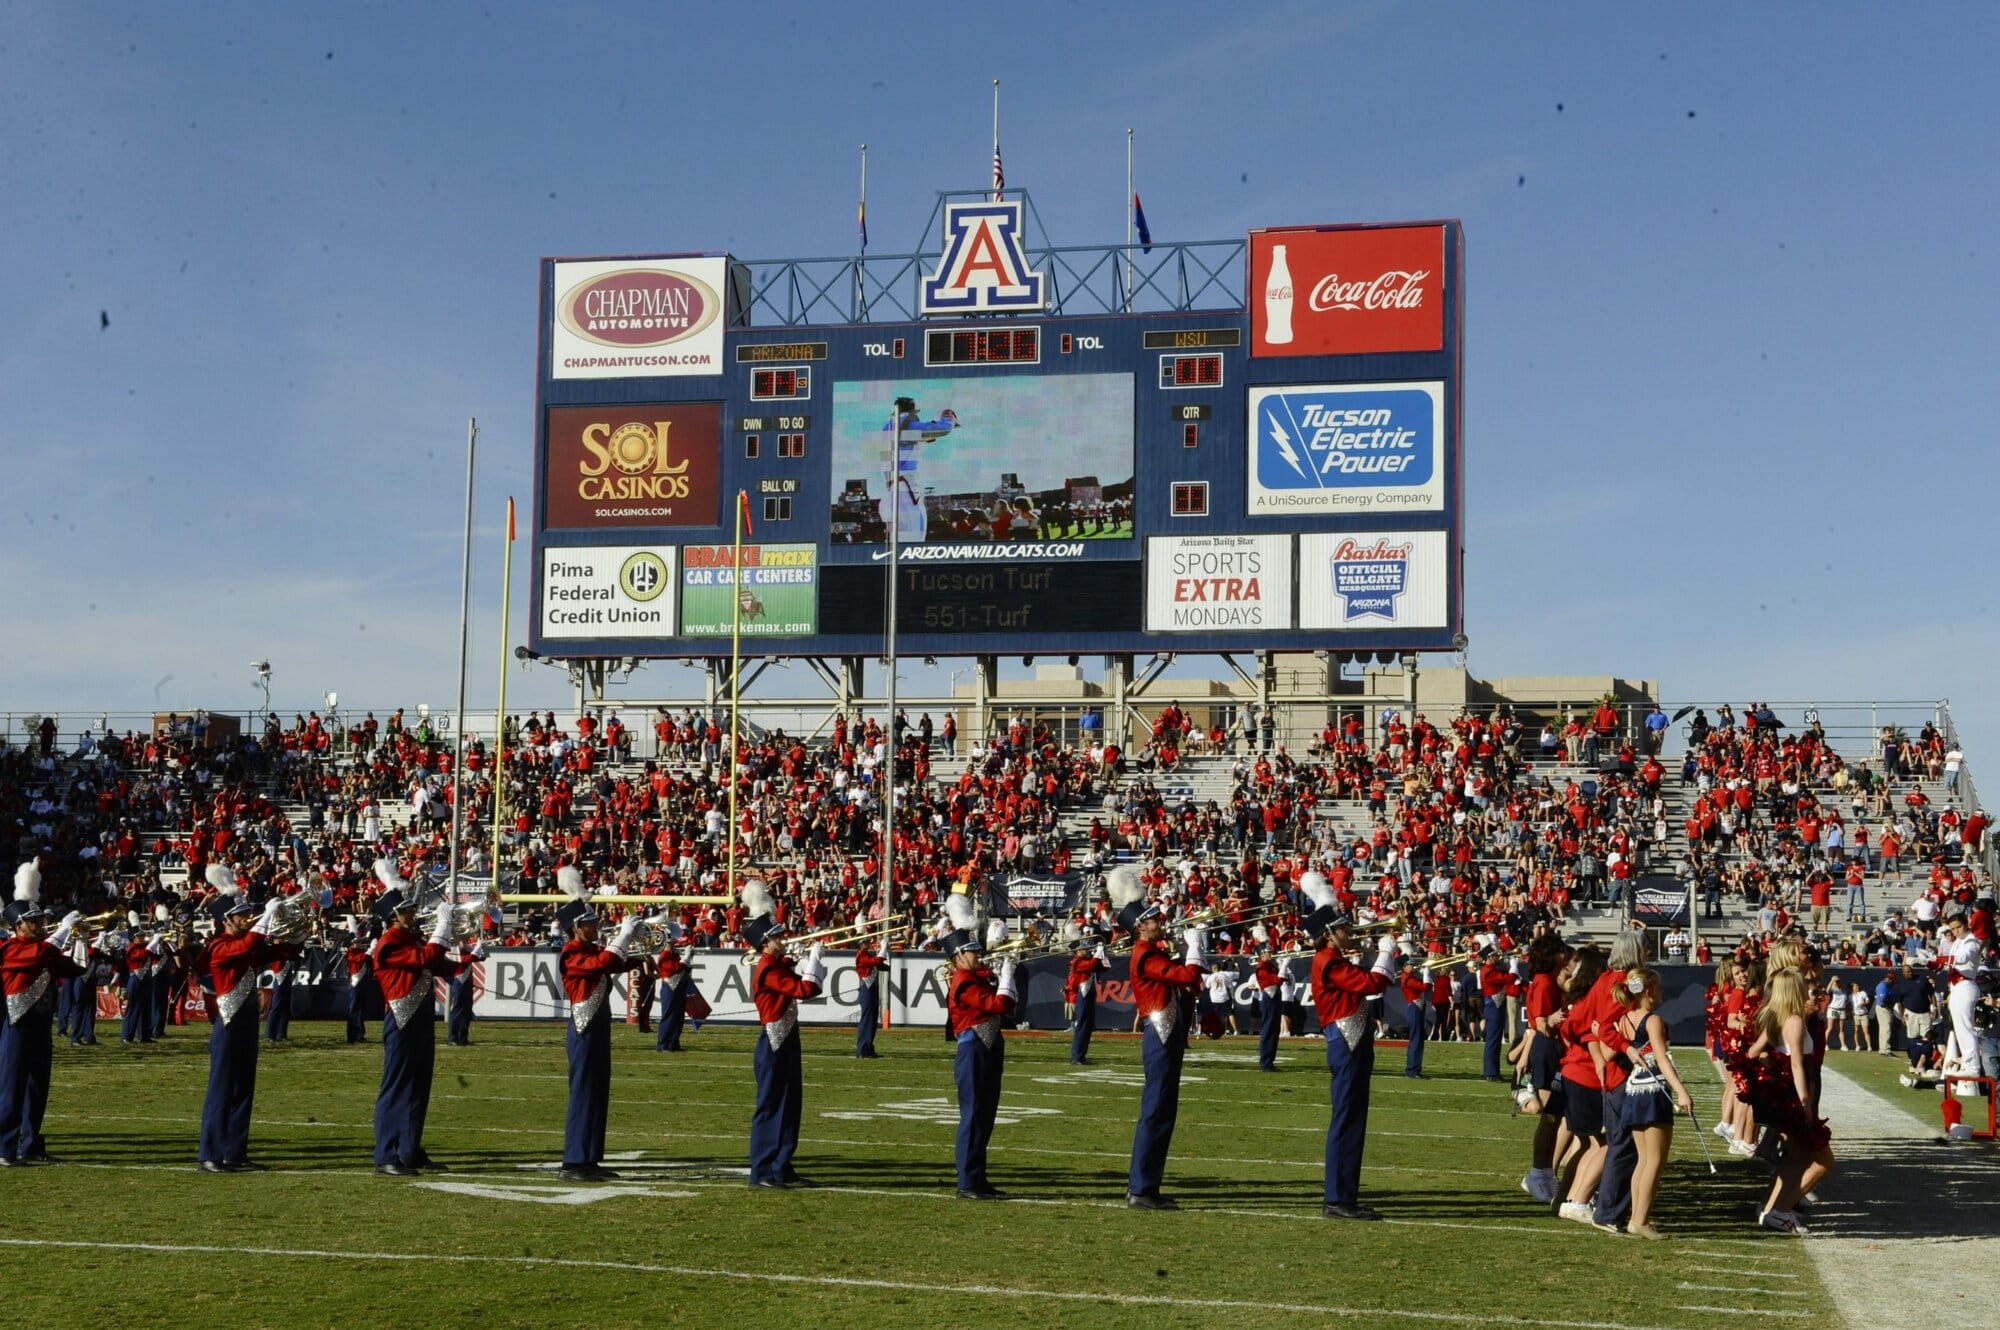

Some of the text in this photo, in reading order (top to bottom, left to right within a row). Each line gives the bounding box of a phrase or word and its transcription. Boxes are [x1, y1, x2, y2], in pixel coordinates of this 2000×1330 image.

[921, 201, 1044, 314] A
[1309, 270, 1430, 312] Coca-Cola
[585, 287, 692, 319] CHAPMAN
[588, 317, 689, 330] AUTOMOTIVE
[953, 330, 1037, 361] 7:26
[1076, 337, 1104, 350] TOL
[1175, 332, 1207, 347] WSU
[752, 345, 813, 361] ARIZONA
[863, 344, 890, 356] TOL
[564, 354, 711, 368] CHAPMANTUCSON.COM
[1175, 357, 1220, 384] 00
[754, 370, 796, 396] 34
[1182, 406, 1199, 419] QTR
[1302, 404, 1391, 428] Tucson
[743, 418, 762, 430] DWN
[779, 417, 804, 429] TO GO
[1310, 426, 1416, 450] Electric
[579, 421, 689, 475] SOL
[1321, 451, 1415, 474] Power
[578, 476, 689, 500] CASINOS
[762, 480, 795, 492] BALL ON
[1256, 492, 1432, 506] A UniSource Energy Company
[595, 507, 672, 517] SOLCASINOS.COM
[1180, 536, 1255, 548] Arizona Daily Star
[684, 546, 815, 568] BRAKE max
[900, 543, 1084, 560] ARIZONAWILDCATS.COM
[550, 563, 594, 578] Pima
[1173, 552, 1261, 574] SPORTS
[1338, 564, 1401, 574] OFFICIAL
[686, 569, 713, 585] CAR
[755, 568, 812, 584] CENTERS
[907, 567, 1052, 591] Tucson Turf
[1338, 575, 1401, 584] TAILGATE
[550, 584, 615, 600] Federal
[1174, 577, 1261, 602] EXTRA
[1338, 584, 1401, 592] HEADQUARTERS
[1349, 599, 1392, 608] ARIZONA
[549, 608, 660, 624] Credit Union
[924, 605, 1032, 627] 551-Turf
[1174, 607, 1262, 625] MONDAYS
[1805, 711, 1817, 723] 30
